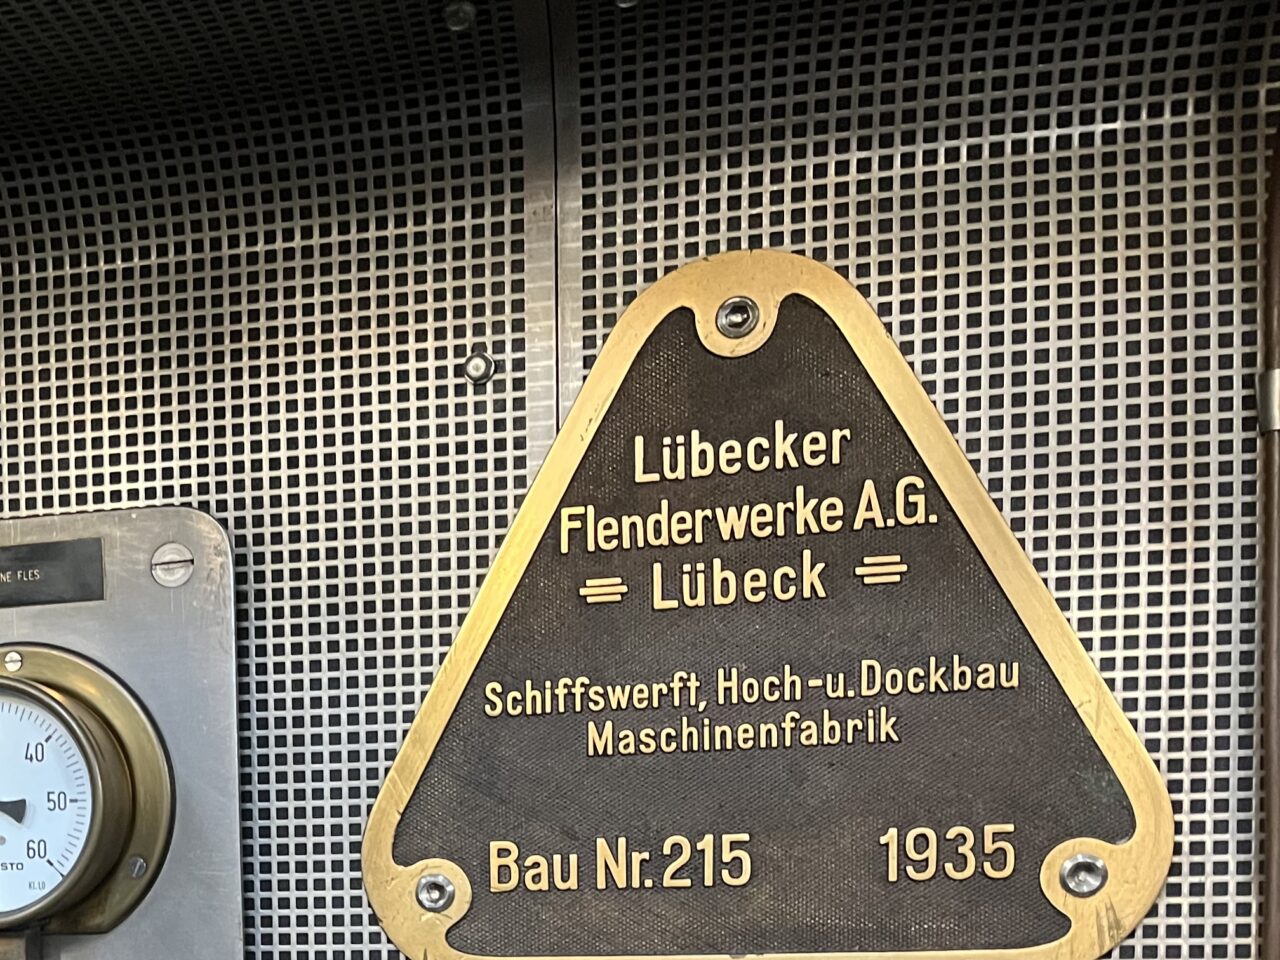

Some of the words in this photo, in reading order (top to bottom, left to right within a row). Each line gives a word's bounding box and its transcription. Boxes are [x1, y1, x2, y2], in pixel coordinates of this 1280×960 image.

[634, 419, 851, 484] Lübecker
[560, 484, 844, 554] Flenderwerke
[852, 475, 938, 531] A.G.
[17, 568, 40, 581] FLES
[652, 549, 827, 611] Lübeck
[483, 670, 707, 718] Schiffswerft,
[24, 742, 44, 763] 40
[587, 706, 900, 757] Maschinenfabrik
[46, 791, 67, 811] 50
[26, 839, 47, 859] 60
[489, 839, 579, 893] Bau
[879, 823, 1016, 882] 1935
